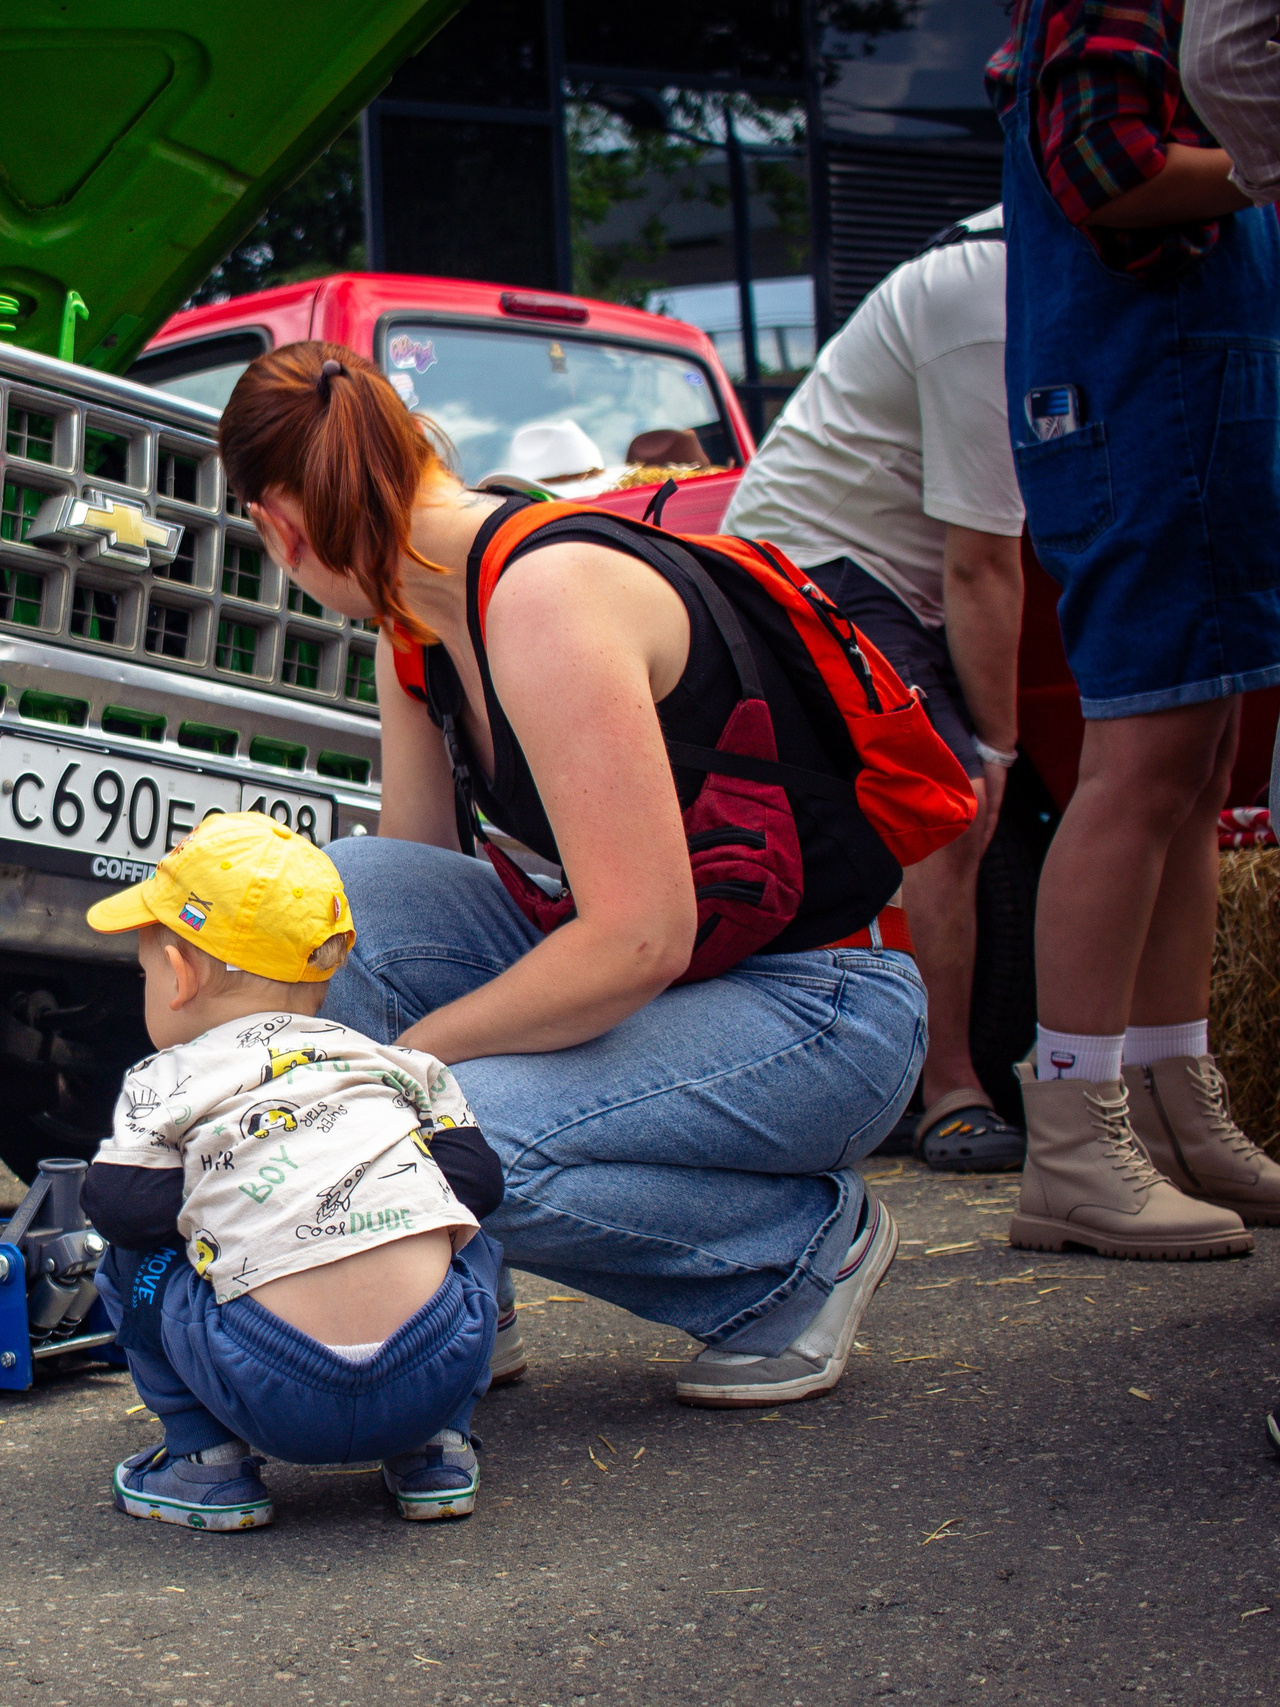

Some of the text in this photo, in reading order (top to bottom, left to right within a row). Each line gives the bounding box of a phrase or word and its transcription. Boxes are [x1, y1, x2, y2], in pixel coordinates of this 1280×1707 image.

[11, 762, 227, 853] C690E
[317, 1104, 348, 1133] SUPER
[238, 1144, 299, 1204] BOY
[350, 1208, 417, 1235] DUDE
[138, 1246, 178, 1305] MOVE
